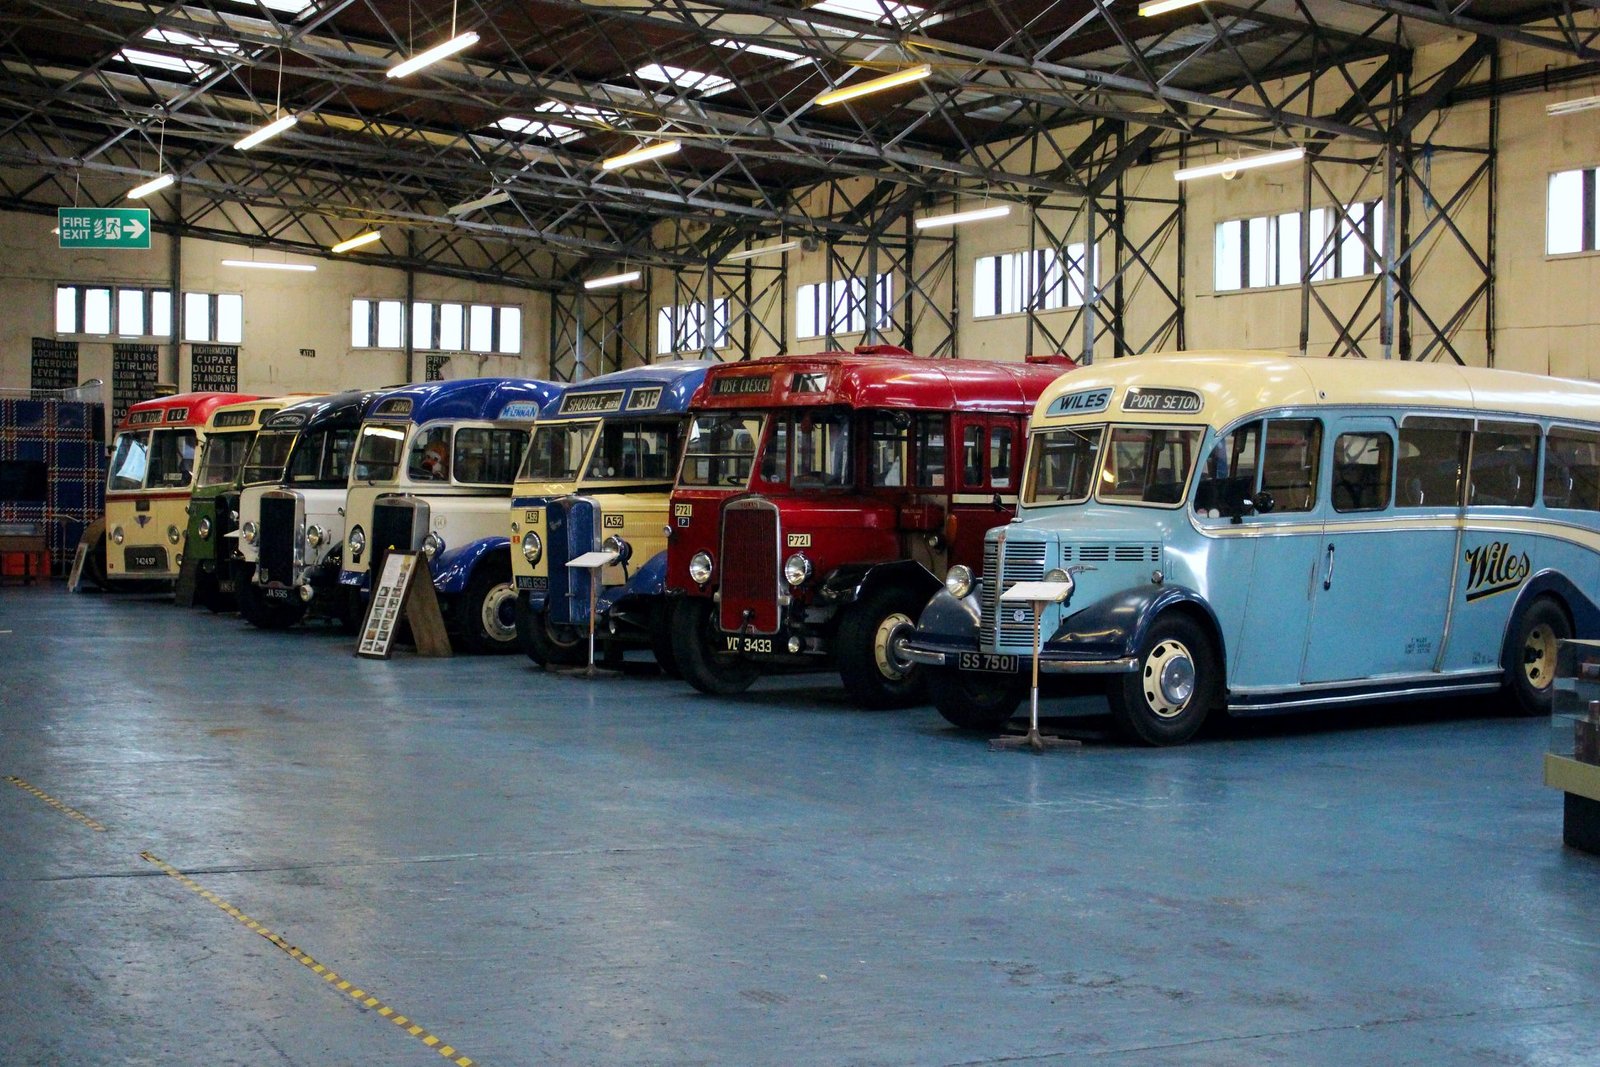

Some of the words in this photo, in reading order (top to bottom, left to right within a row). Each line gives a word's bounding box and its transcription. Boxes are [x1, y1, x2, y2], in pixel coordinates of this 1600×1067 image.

[62, 217, 91, 227] FIRE
[63, 230, 91, 239] EXIT
[32, 350, 78, 359] LOCHGELLY
[114, 353, 158, 361] CULROSS
[196, 355, 232, 364] CUPAR
[33, 360, 78, 368] ABERDOUR
[114, 362, 158, 371] STIRLING
[192, 364, 236, 374] DUNDEE
[33, 369, 60, 377] LEVEN
[203, 374, 236, 383] ANDREWS
[193, 383, 236, 392] FALKLAND
[719, 379, 737, 393] ROSE
[567, 397, 606, 412] SHOUGLE
[636, 392, 658, 408] 31B
[1059, 393, 1107, 410] WILES
[1130, 394, 1159, 408] PORT
[1162, 395, 1199, 410] SETON
[676, 505, 691, 515] P721
[606, 517, 622, 526] A52
[788, 535, 809, 546] P721
[1464, 541, 1531, 592] Wiles
[744, 638, 772, 652] 3433
[962, 653, 980, 668] SS
[983, 654, 1014, 671] 7501
